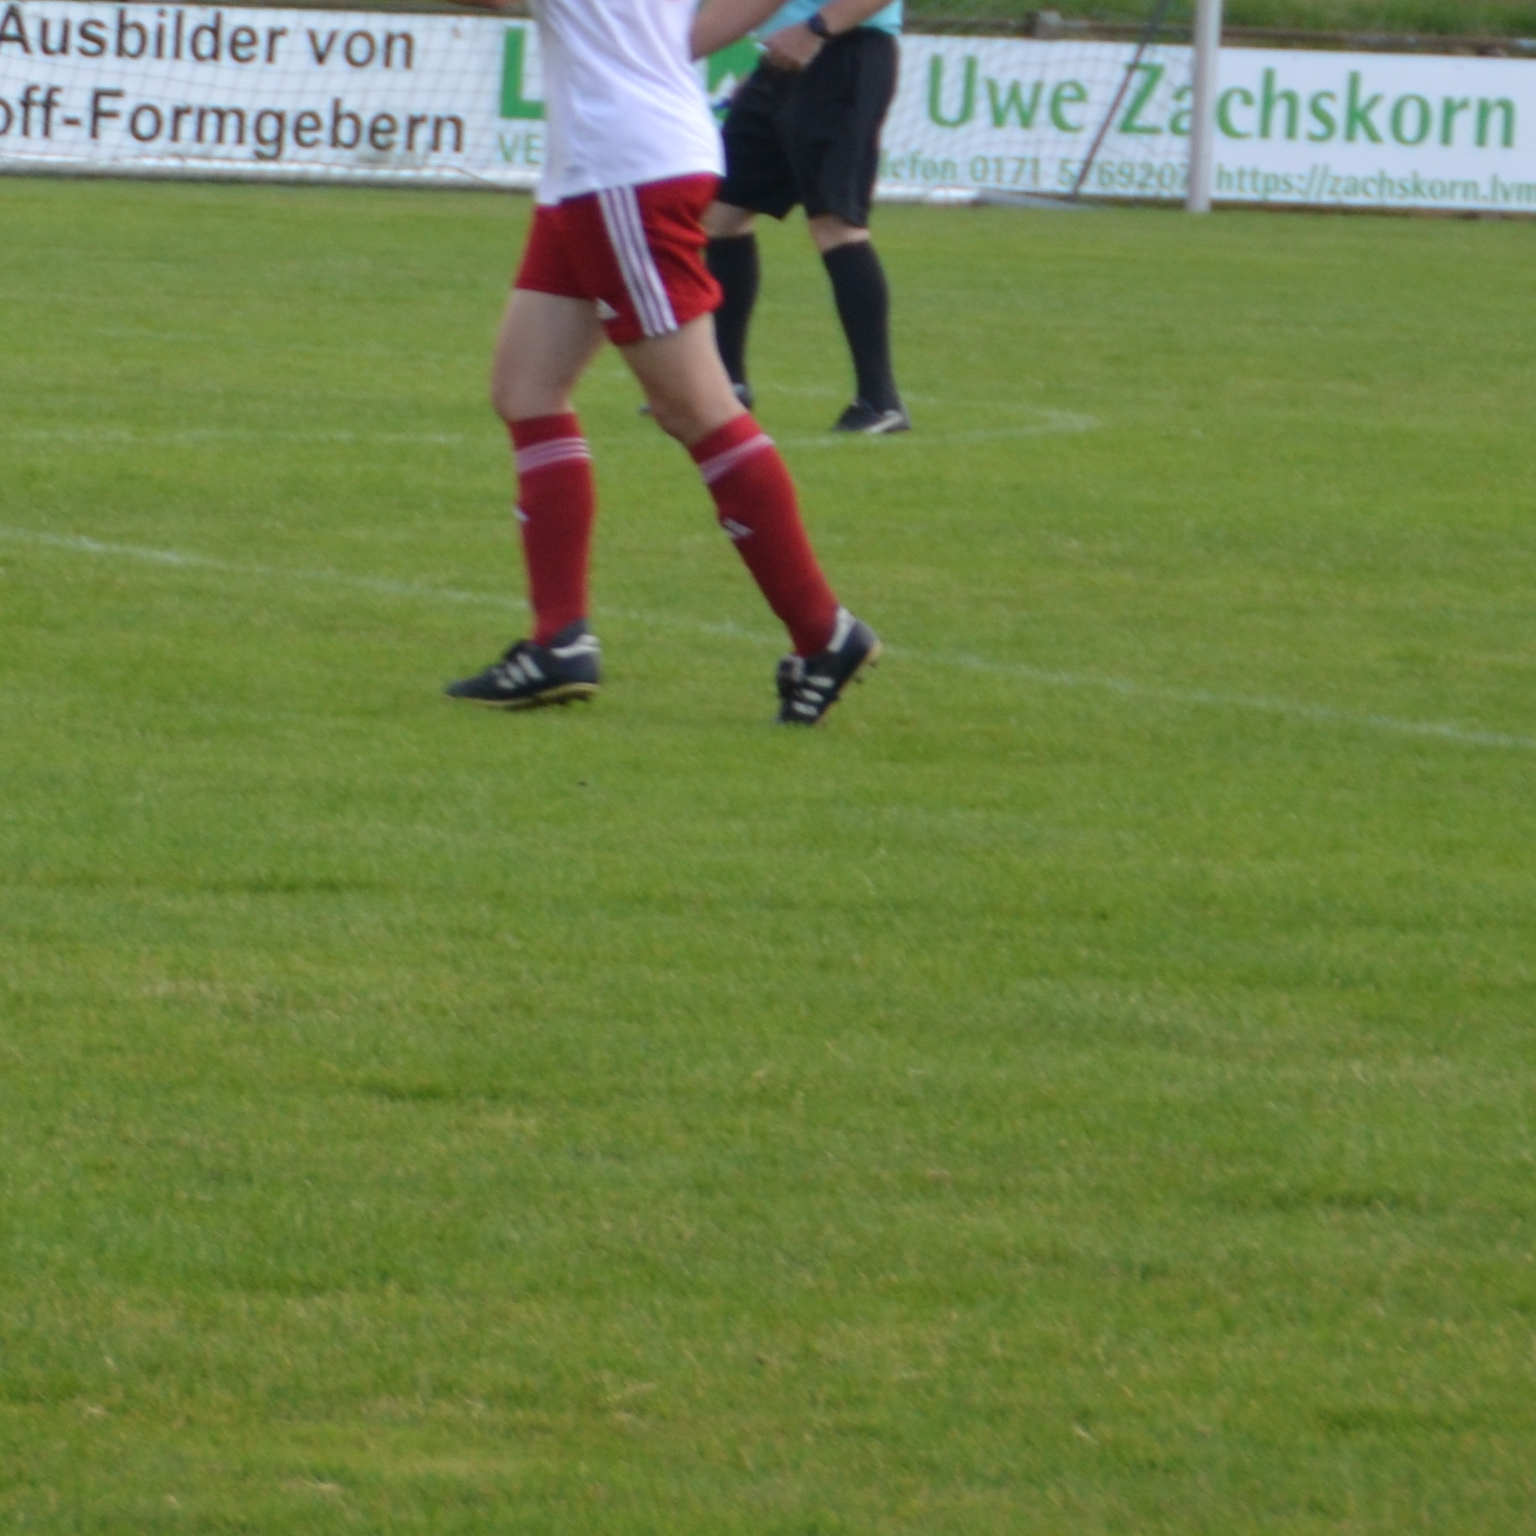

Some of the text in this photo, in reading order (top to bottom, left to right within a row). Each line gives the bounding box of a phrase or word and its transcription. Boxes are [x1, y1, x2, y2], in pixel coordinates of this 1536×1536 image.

[306, 26, 415, 70] von
[929, 54, 1516, 149] Uwe Zachskorn
[970, 155, 1040, 186] 0171
